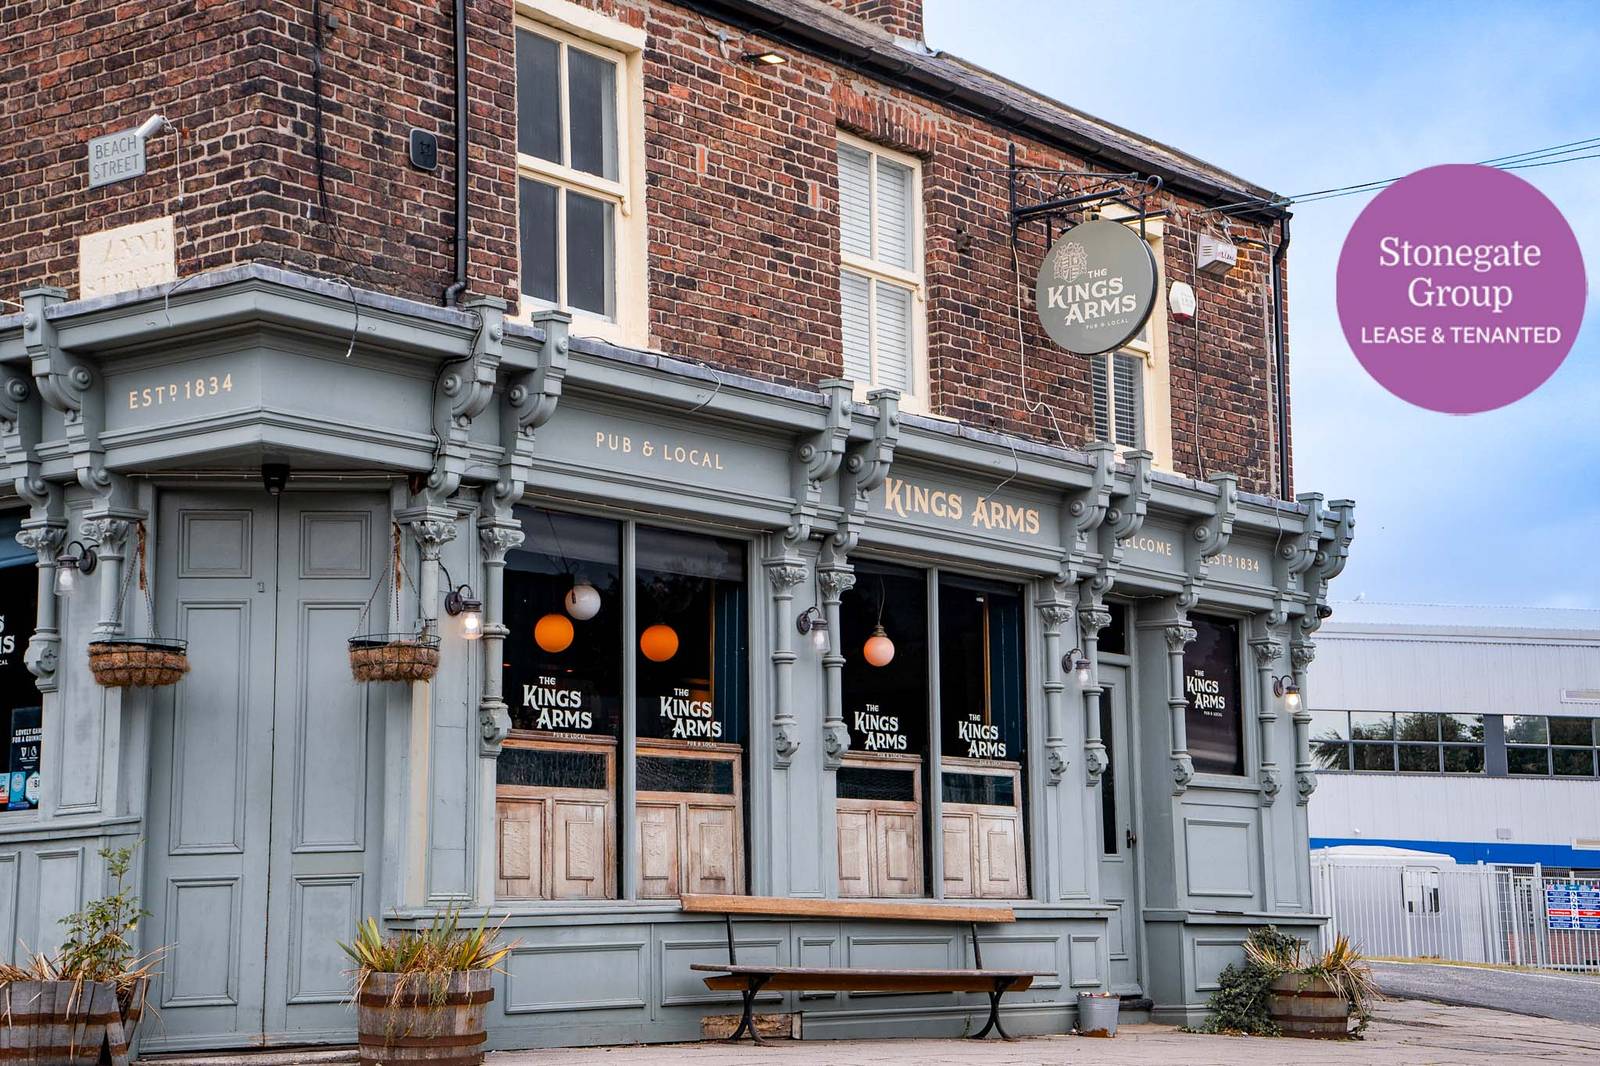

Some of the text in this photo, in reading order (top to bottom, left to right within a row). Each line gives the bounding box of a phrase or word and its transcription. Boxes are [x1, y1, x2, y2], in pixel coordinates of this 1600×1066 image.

[95, 135, 137, 159] BEACH
[93, 153, 140, 179] STREET
[1087, 268, 1108, 279] THE
[1047, 276, 1124, 309] KINGS
[1064, 293, 1137, 326] ARMS
[1107, 318, 1128, 327] LOCAL
[184, 373, 233, 400] 1834
[595, 432, 723, 470] PUB & LOCAL
[884, 477, 1040, 535] KINGS ARMS
[1125, 536, 1172, 556] ELCOME
[1235, 556, 1259, 573] 1834
[539, 676, 556, 686] THE
[1194, 669, 1205, 677] THE
[673, 688, 689, 697] THE
[1186, 676, 1219, 695] KINGS
[522, 684, 582, 711] KINGS
[1194, 692, 1226, 709] ARMS
[659, 696, 713, 720] KINGS
[865, 704, 879, 712] THE
[968, 713, 981, 721] THE
[536, 707, 593, 730] ARMS
[671, 717, 722, 739] ARMS
[854, 711, 899, 734] KINGS
[864, 731, 907, 751] ARMS
[958, 721, 999, 742] KINGS
[968, 740, 1007, 758] ARMS
